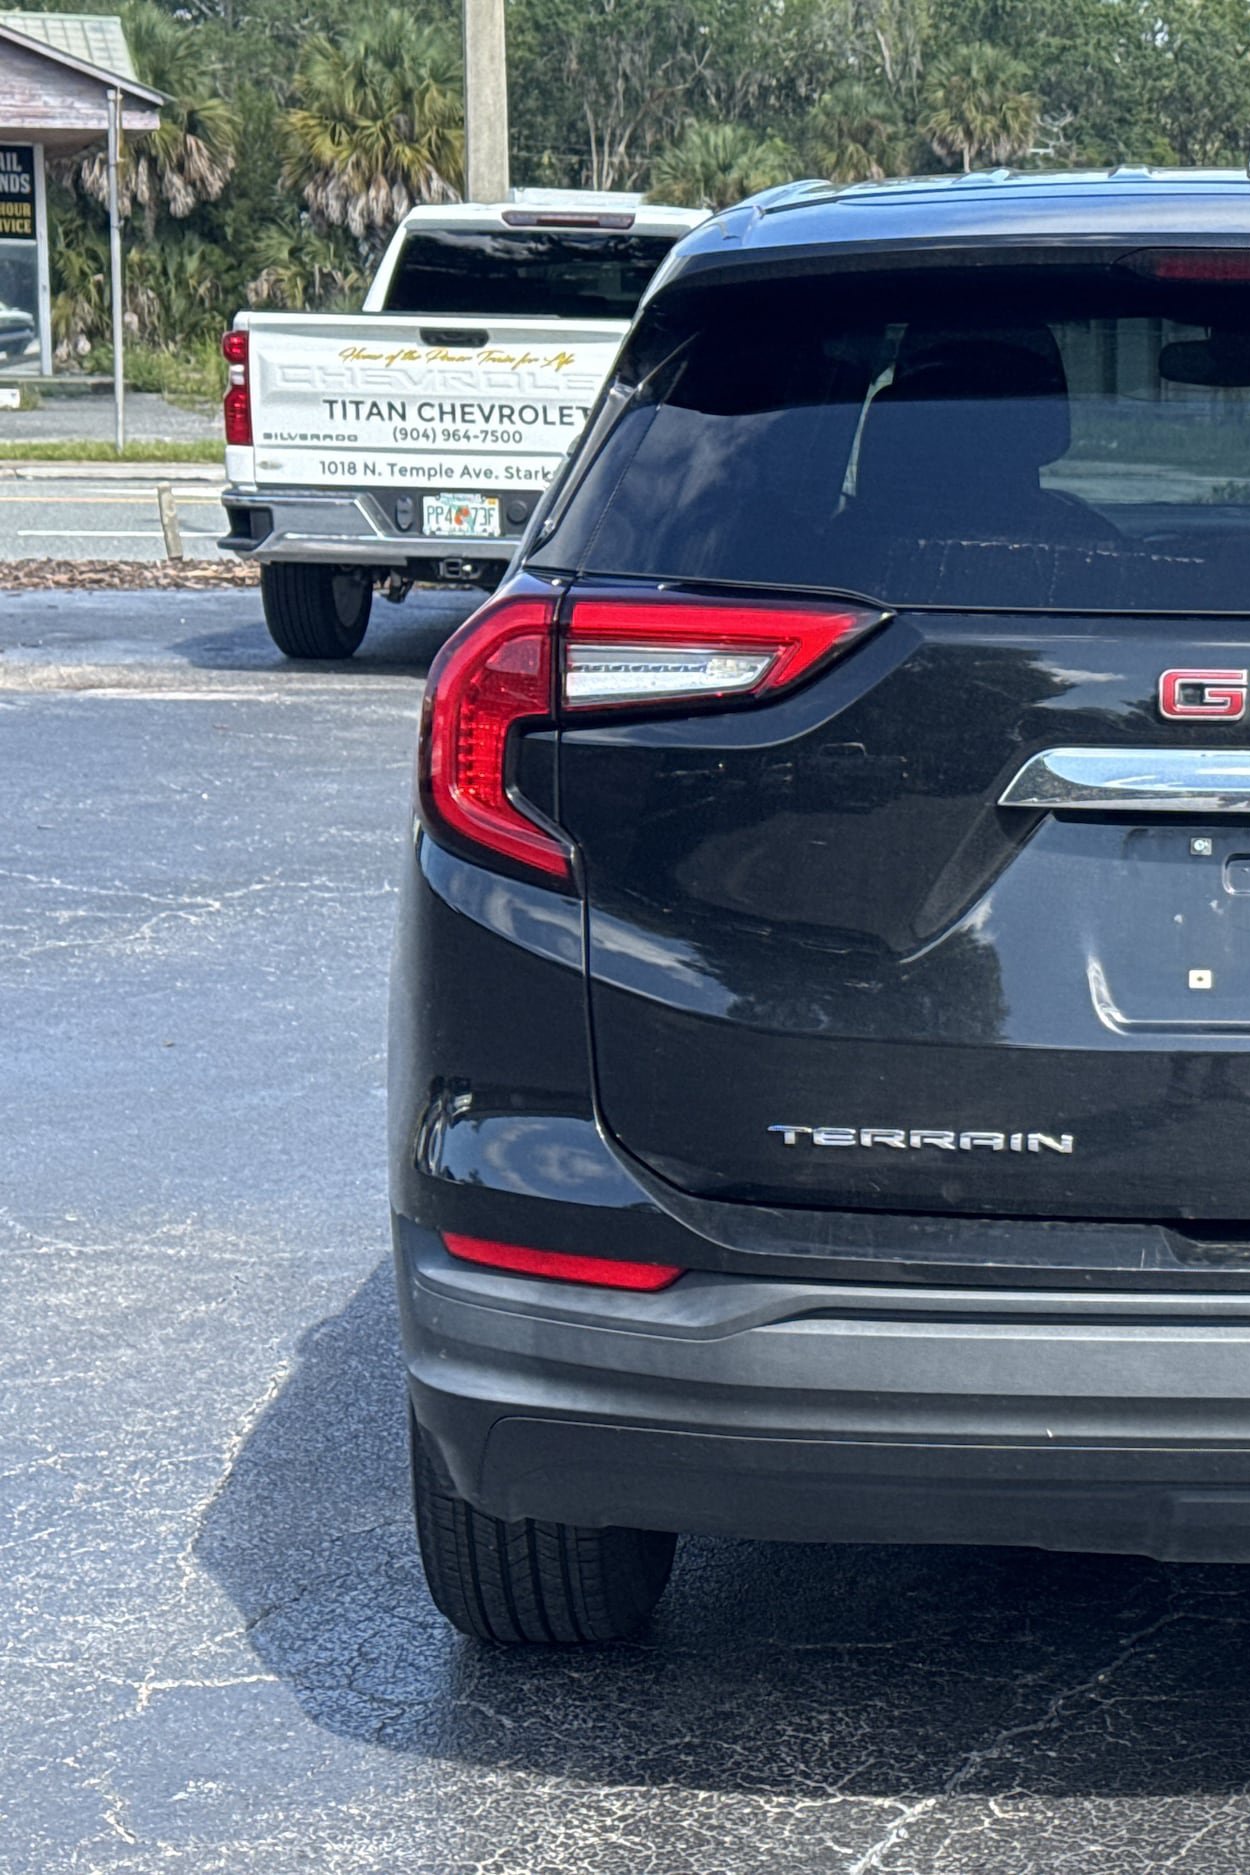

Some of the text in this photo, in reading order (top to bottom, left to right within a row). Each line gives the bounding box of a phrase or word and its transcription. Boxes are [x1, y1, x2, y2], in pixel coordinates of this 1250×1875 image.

[322, 398, 593, 427] TITAN CHEVROLET
[262, 431, 359, 443] SILVERADO
[392, 426, 523, 444] (904) 964-7500
[319, 460, 357, 476] 1018
[363, 461, 382, 477] N.
[386, 462, 454, 482] Temple
[460, 464, 499, 480] Ave.
[767, 1124, 1074, 1153] TERRAIN
